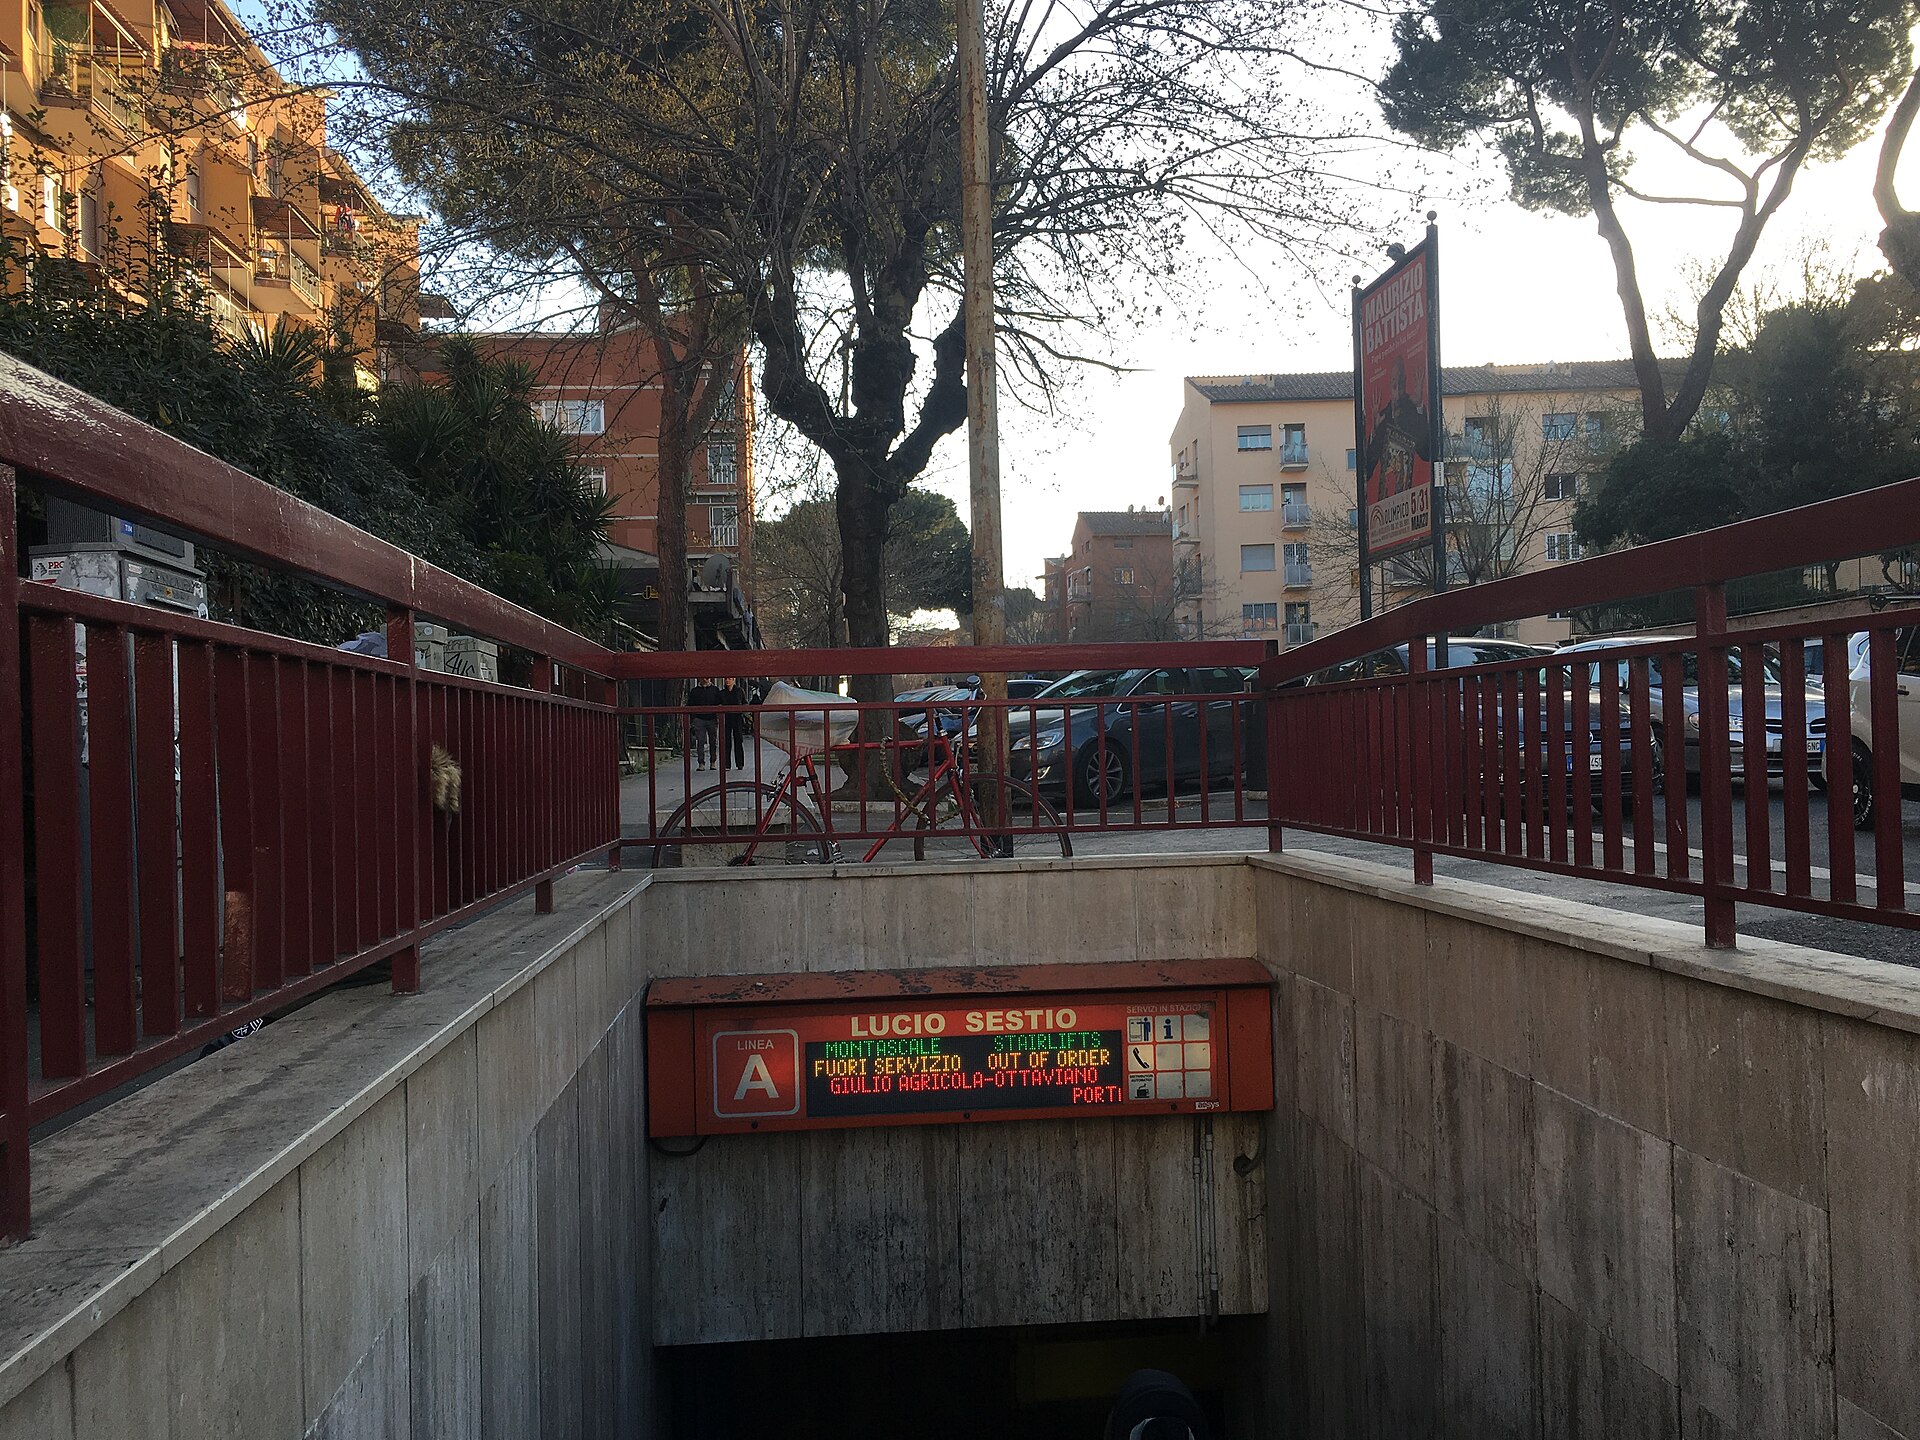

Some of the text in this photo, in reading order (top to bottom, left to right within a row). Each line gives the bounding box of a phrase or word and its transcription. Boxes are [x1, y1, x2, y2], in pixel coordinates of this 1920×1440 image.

[1365, 262, 1423, 329] MAURIZIO
[1365, 292, 1425, 354] BATTISTA
[1384, 501, 1409, 524] OLIMPICO
[1410, 487, 1429, 515] 5/31
[1410, 512, 1429, 531] MARZO
[851, 1008, 1077, 1037] LUCIO SESTIO
[1126, 1005, 1158, 1014] SERVIZI
[1159, 1005, 1168, 1013] IN
[737, 1039, 775, 1051] LINEA
[825, 1031, 1101, 1059] MONTASCALE STAIRLIFTS
[733, 1054, 780, 1100] A
[814, 1048, 1111, 1078] FUORI SERVIZIO OUT OF ORDER
[830, 1066, 1099, 1095] GIULIO AGRICOLA-OTTAVIANO
